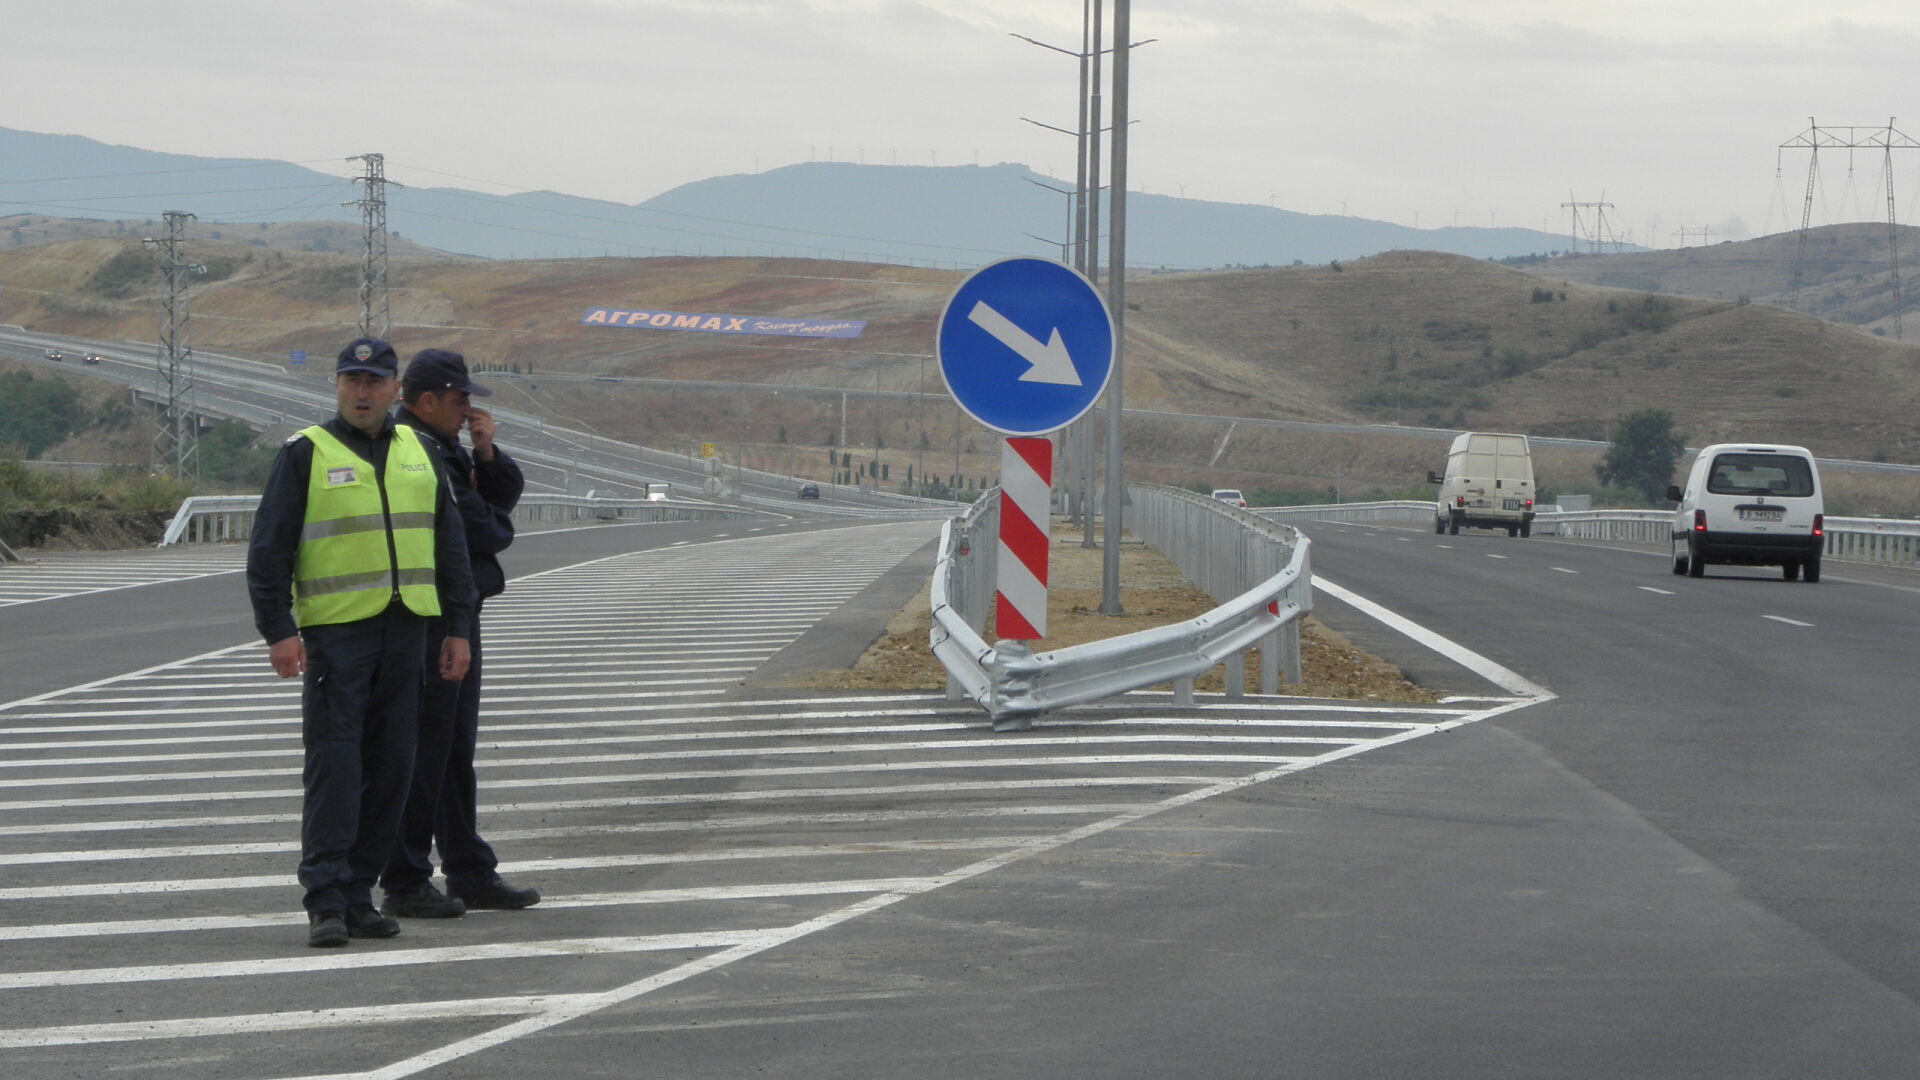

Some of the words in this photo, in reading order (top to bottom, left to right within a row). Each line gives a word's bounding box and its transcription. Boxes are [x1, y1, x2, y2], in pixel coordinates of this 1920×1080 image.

[585, 310, 748, 331] АГРОМАХ
[400, 463, 428, 472] POLICE
[1505, 500, 1519, 510] TIR
